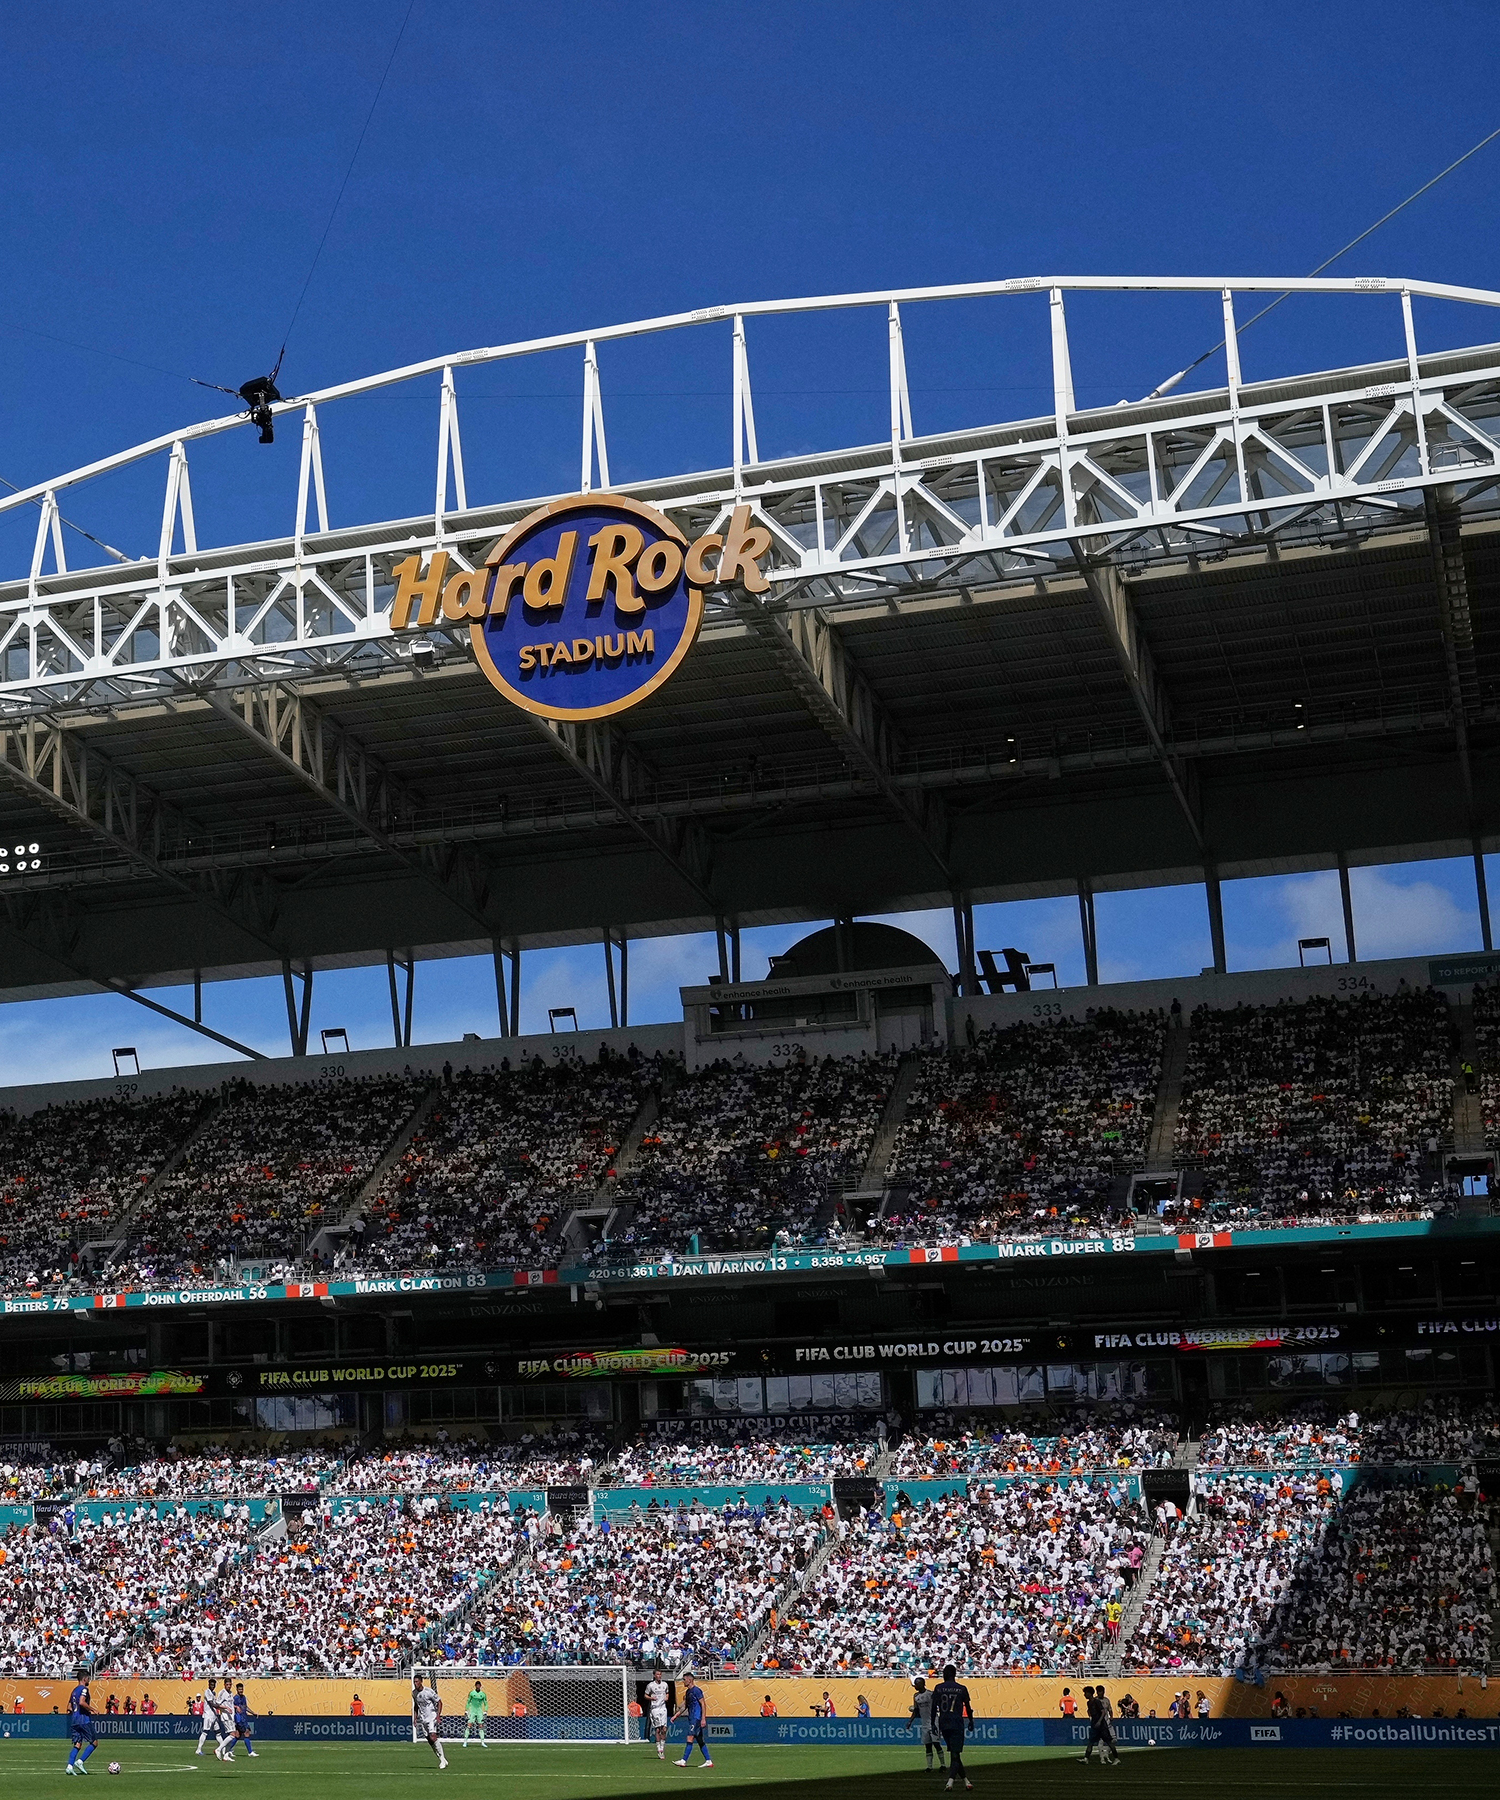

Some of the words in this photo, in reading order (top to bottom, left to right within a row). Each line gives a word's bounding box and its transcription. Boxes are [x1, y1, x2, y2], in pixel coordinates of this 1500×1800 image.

[390, 531, 579, 630] Hard
[586, 505, 772, 614] Rock
[518, 629, 655, 671] STADIUM
[844, 979, 882, 988] enhance
[884, 976, 913, 984] health
[1338, 976, 1369, 990] 334
[724, 991, 761, 1000] enhance
[763, 987, 790, 996] health
[1033, 1003, 1062, 1016] 333
[552, 1045, 576, 1058] 331
[773, 1043, 800, 1057] 332
[320, 1065, 345, 1078] 330
[115, 1084, 138, 1095] 329
[1112, 1238, 1136, 1252] 85
[769, 1257, 787, 1272] 13
[811, 1256, 844, 1268] 8,358
[854, 1254, 887, 1266] 4,967
[466, 1274, 487, 1288] 83
[249, 1286, 268, 1300] 56
[53, 1298, 69, 1310] 75
[1417, 1320, 1458, 1334] FIFA
[1094, 1334, 1133, 1348] FIFA
[1136, 1332, 1181, 1348] CLUB
[1184, 1328, 1251, 1344] WORLD
[1254, 1328, 1290, 1342] CUP
[796, 1348, 830, 1362] FIFA
[834, 1345, 876, 1360] CLUB
[879, 1342, 940, 1358] WORLD
[943, 1340, 978, 1355] CUP
[518, 1359, 551, 1374] FIFA
[554, 1358, 592, 1372] CLUB
[596, 1356, 650, 1370] WORLD
[656, 1354, 686, 1367] CUP
[260, 1371, 290, 1384] FIFA
[293, 1369, 330, 1384] CLUB
[332, 1368, 384, 1382] WORLD
[388, 1365, 417, 1379] CUP
[940, 1694, 958, 1712] 87
[137, 1721, 170, 1734] UNITES
[173, 1720, 189, 1734] the
[1132, 1725, 1174, 1740] UNITES
[1177, 1724, 1199, 1740] the
[1254, 1730, 1278, 1738] FIFA
